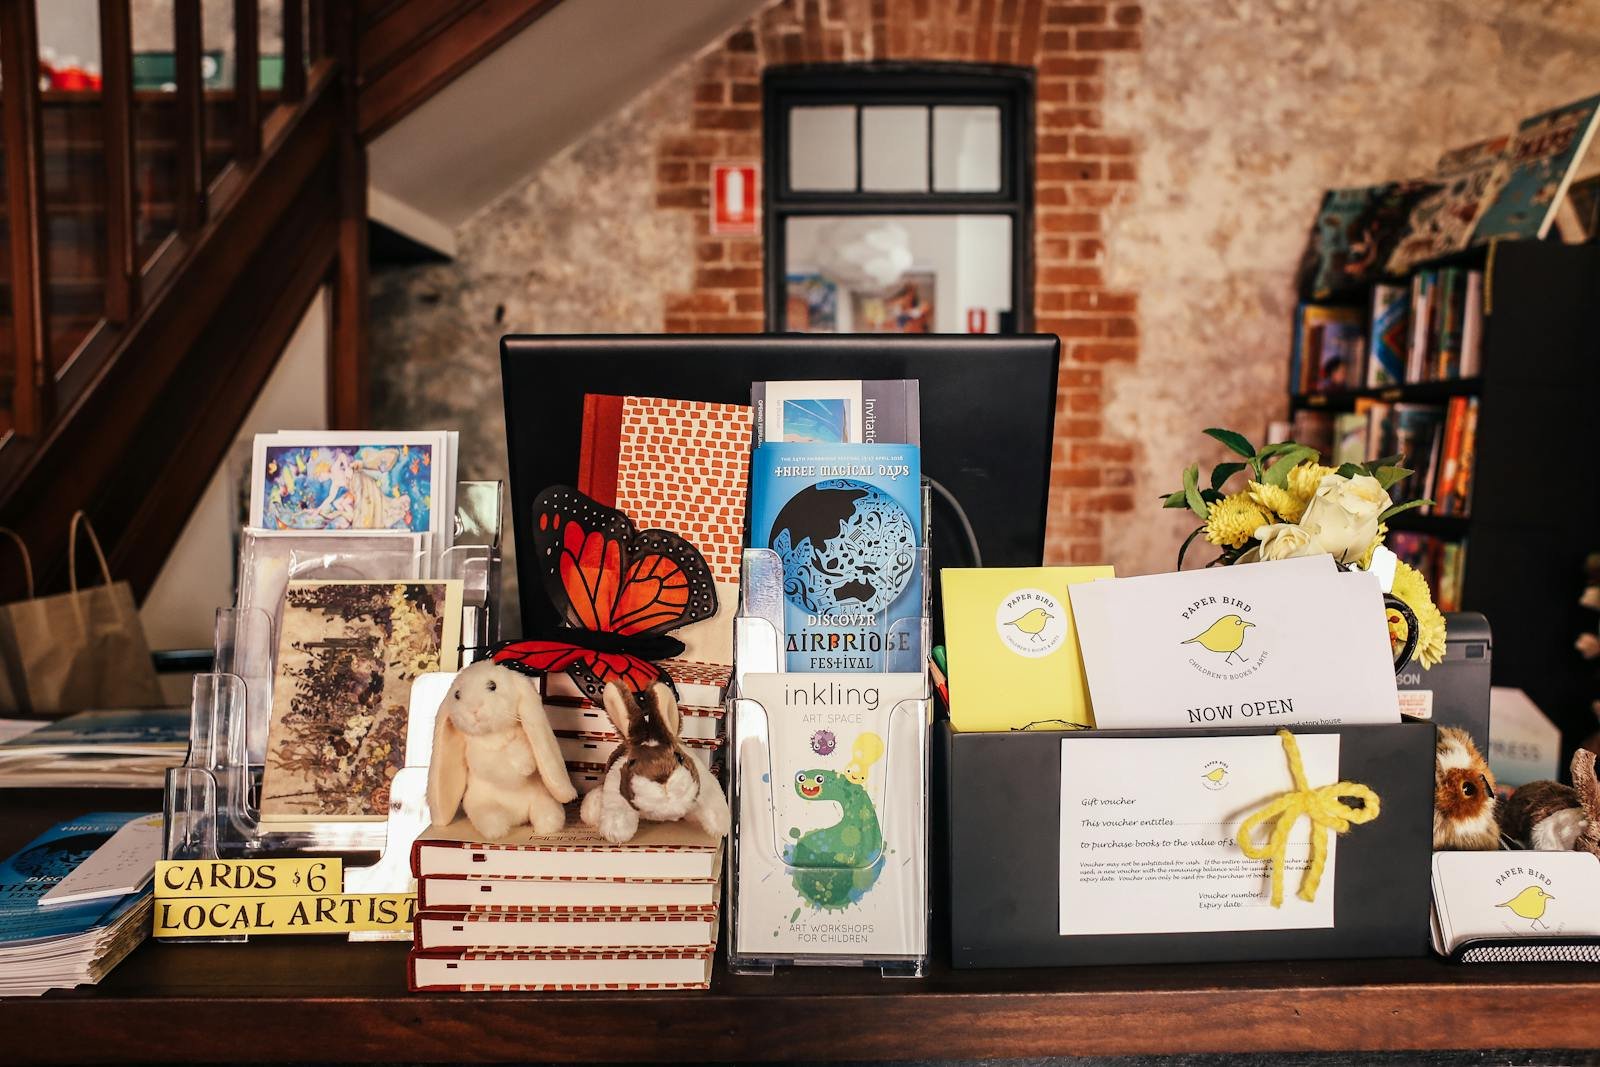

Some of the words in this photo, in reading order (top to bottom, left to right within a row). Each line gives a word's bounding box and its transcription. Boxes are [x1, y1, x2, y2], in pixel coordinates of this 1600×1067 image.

[865, 399, 876, 444] Invitatio
[774, 465, 816, 477] THREE
[820, 464, 874, 476] MAGICAL
[879, 465, 910, 480] DAYS
[1008, 594, 1032, 608] PAPER
[1036, 594, 1054, 608] BIRD
[1182, 596, 1217, 620] PAPER
[1222, 596, 1252, 614] BIRD
[807, 610, 876, 626] DISCOVER
[810, 654, 874, 669] FESTIVAL
[1188, 658, 1228, 680] CHILDREN'S
[1229, 670, 1252, 680] BOOKS
[1256, 650, 1268, 668] ARTS
[1396, 674, 1421, 685] SON
[785, 682, 879, 710] inkling
[802, 714, 822, 724] ART
[828, 714, 863, 724] SPACE
[1187, 704, 1234, 724] NOW
[1240, 698, 1294, 718] OPEN
[1081, 798, 1098, 807] Gift
[1100, 797, 1136, 806] voucher
[1081, 820, 1100, 828] This
[1102, 818, 1138, 827] voucher
[1140, 818, 1174, 826] entitles
[1080, 840, 1090, 849] to
[1092, 839, 1132, 850] purchase
[1135, 839, 1160, 848] books
[1174, 838, 1188, 847] the
[1190, 838, 1215, 846] value
[1218, 838, 1228, 848] of
[164, 863, 276, 891] CARDS
[1496, 867, 1524, 886] PAPER
[1528, 868, 1552, 886] BIRD
[162, 902, 274, 930] LOCAL
[790, 924, 806, 933] ART
[810, 924, 874, 933] WORKSHOPS
[798, 934, 818, 942] FOR
[820, 934, 868, 943] CHILDREN
